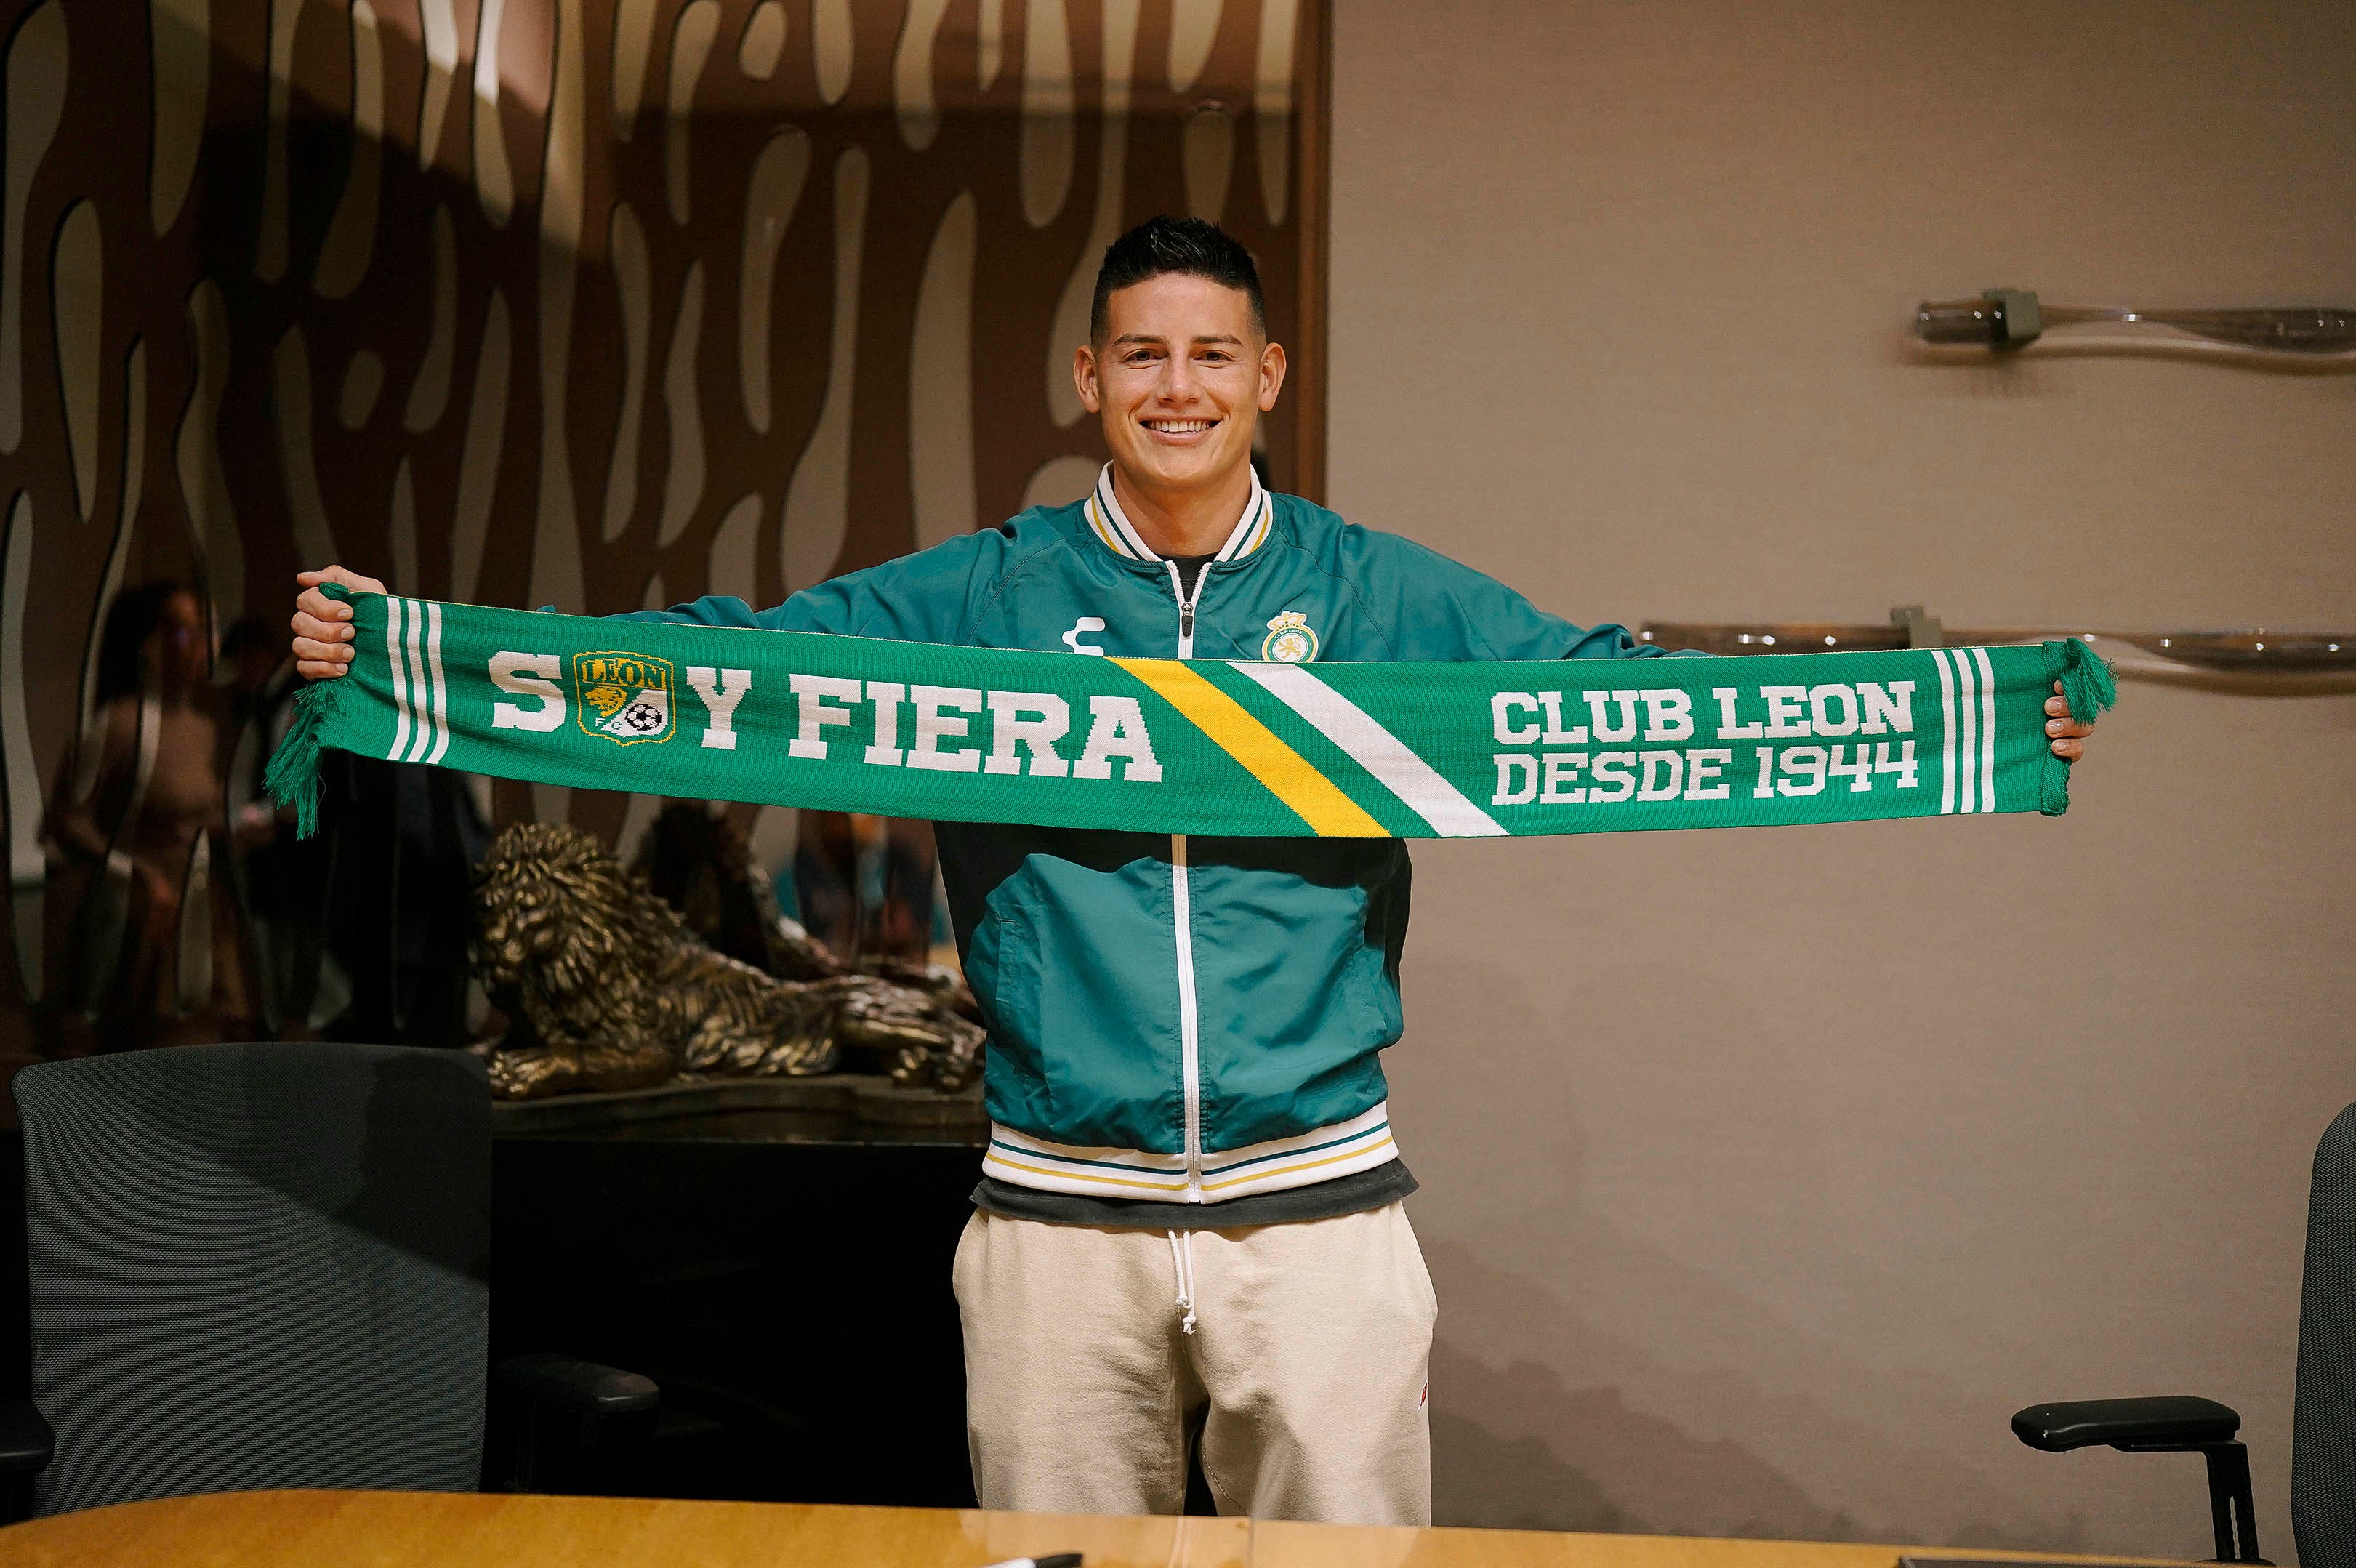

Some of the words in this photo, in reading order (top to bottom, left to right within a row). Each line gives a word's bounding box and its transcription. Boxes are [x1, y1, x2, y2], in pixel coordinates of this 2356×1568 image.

[584, 659, 664, 688] LEON
[686, 666, 752, 750] Y
[788, 674, 1163, 782] FIERA
[1491, 689, 1694, 744] CLUB
[1713, 681, 1916, 739] LEON
[1492, 748, 1732, 805] DESDE
[1753, 740, 1918, 798] 1944
